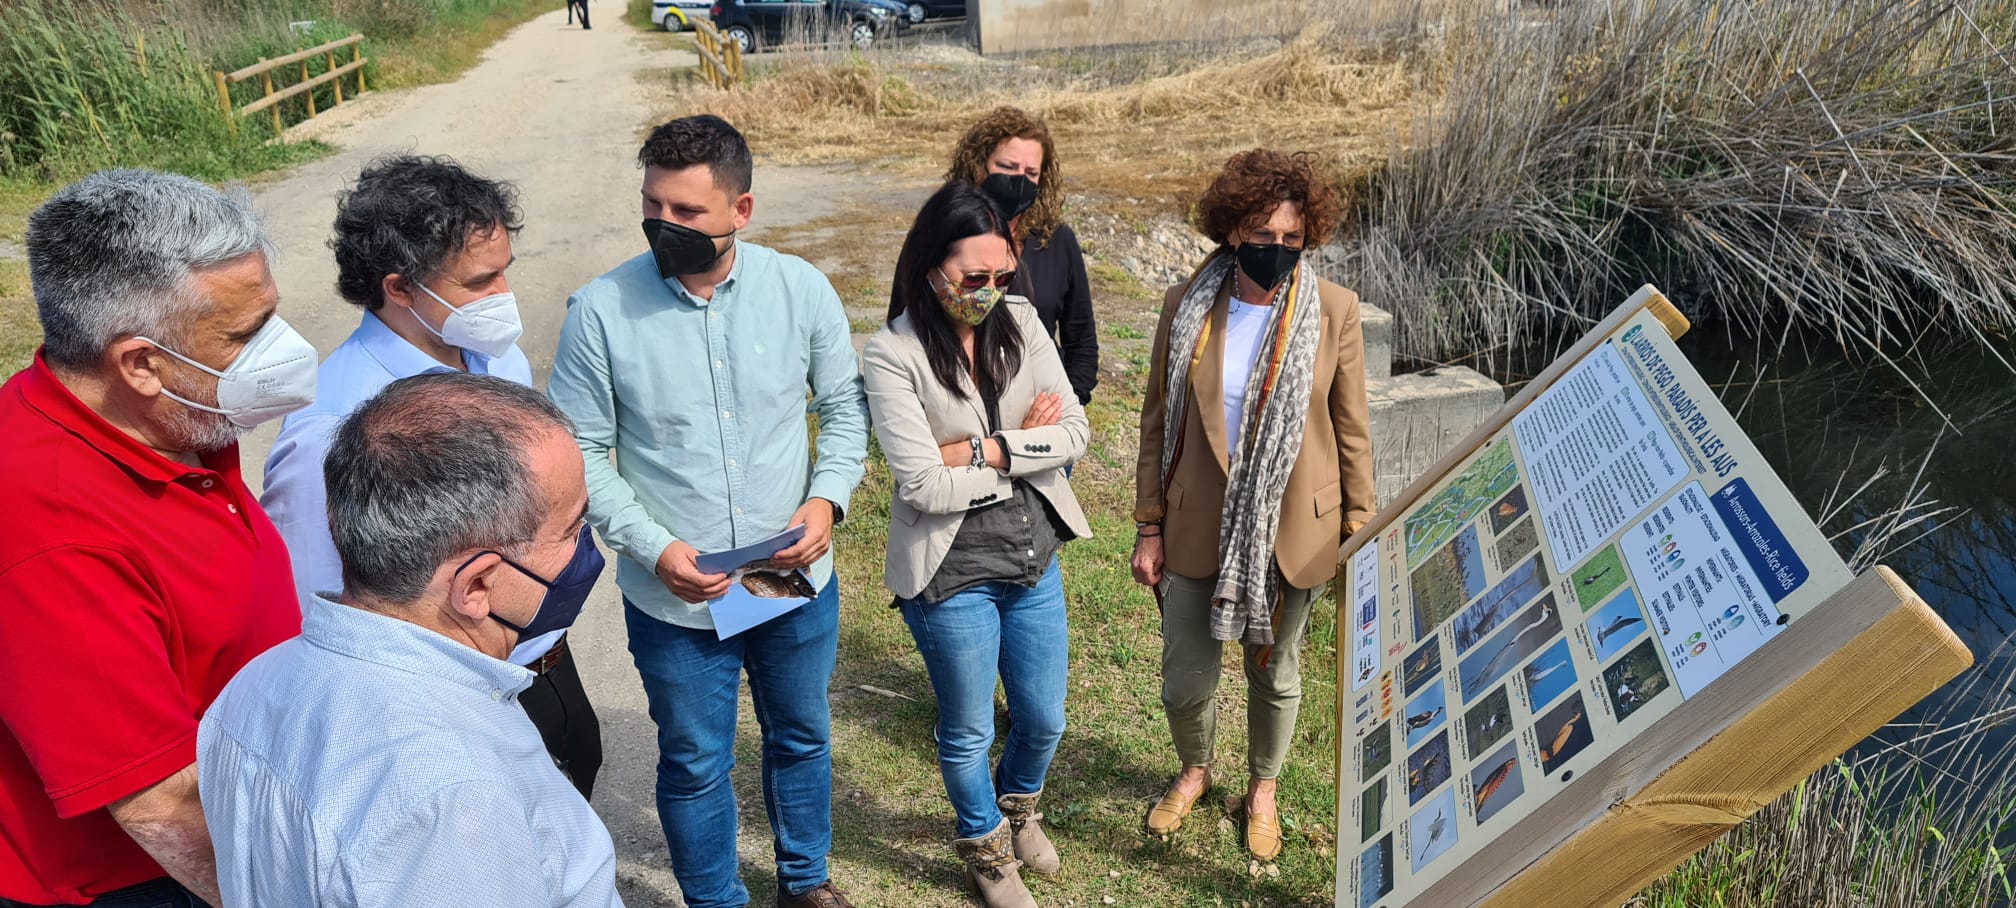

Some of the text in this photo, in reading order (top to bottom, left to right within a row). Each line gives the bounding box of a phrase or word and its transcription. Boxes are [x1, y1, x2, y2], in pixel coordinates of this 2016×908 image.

[1644, 352, 1663, 371] DE
[1651, 362, 1676, 392] PEGO,
[1664, 381, 1699, 420] PARADÍS
[1684, 411, 1709, 436] PER
[1694, 426, 1714, 444] A
[1699, 433, 1725, 459] LES
[1709, 448, 1738, 478] AUS
[1727, 493, 1798, 591] Arrossars-Arrozales-Rice fields
[1751, 600, 1771, 628] MIGRATORY
